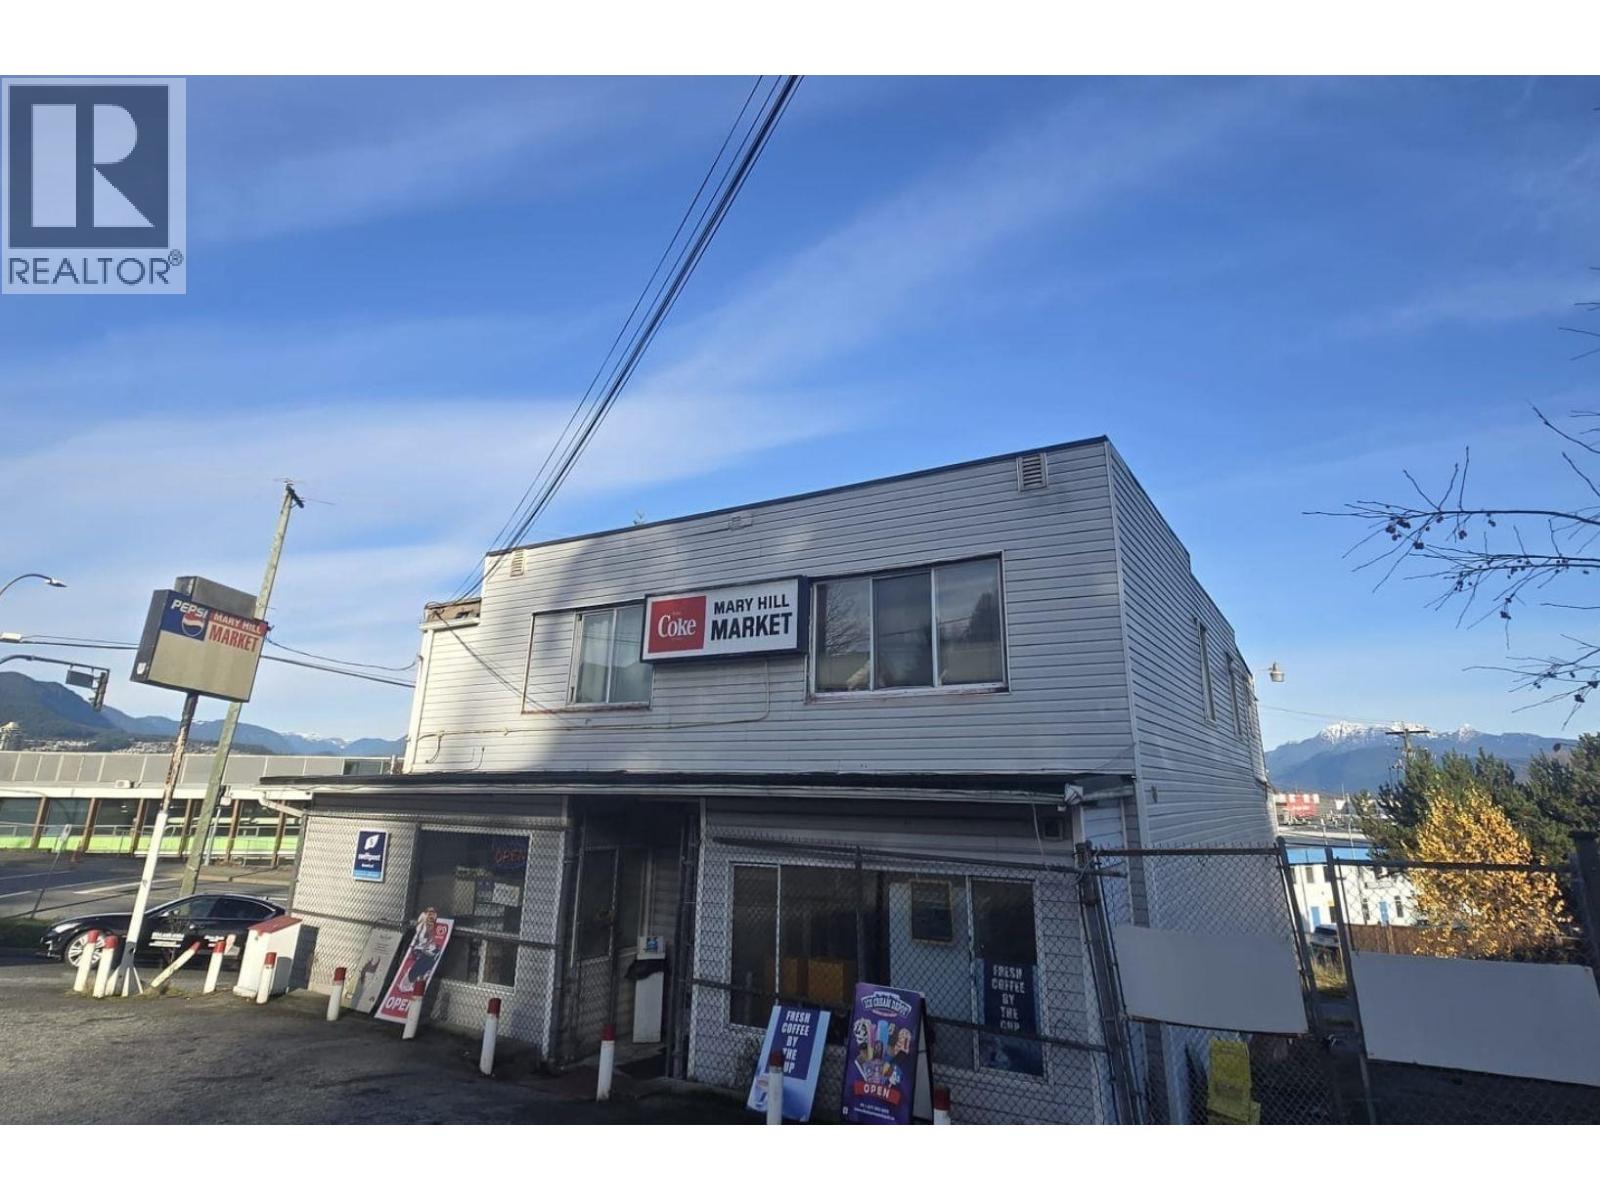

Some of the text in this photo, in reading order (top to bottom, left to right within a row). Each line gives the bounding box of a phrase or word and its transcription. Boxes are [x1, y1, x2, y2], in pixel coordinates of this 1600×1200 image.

[171, 600, 209, 619] PEPSI
[714, 594, 790, 615] MARY HILL
[213, 612, 261, 633] MARY HILL
[658, 614, 697, 638] Coke
[711, 612, 793, 641] MARKET
[208, 624, 260, 653] MARKET
[993, 965, 1023, 979] FRESH
[991, 978, 1026, 994] COFFEE
[1002, 993, 1016, 1005] BY
[786, 1010, 811, 1023] FRESH
[1000, 1006, 1019, 1020] THE
[781, 1022, 810, 1037] COFFEE
[786, 1035, 799, 1047] BY
[864, 1083, 890, 1099] OPEN
